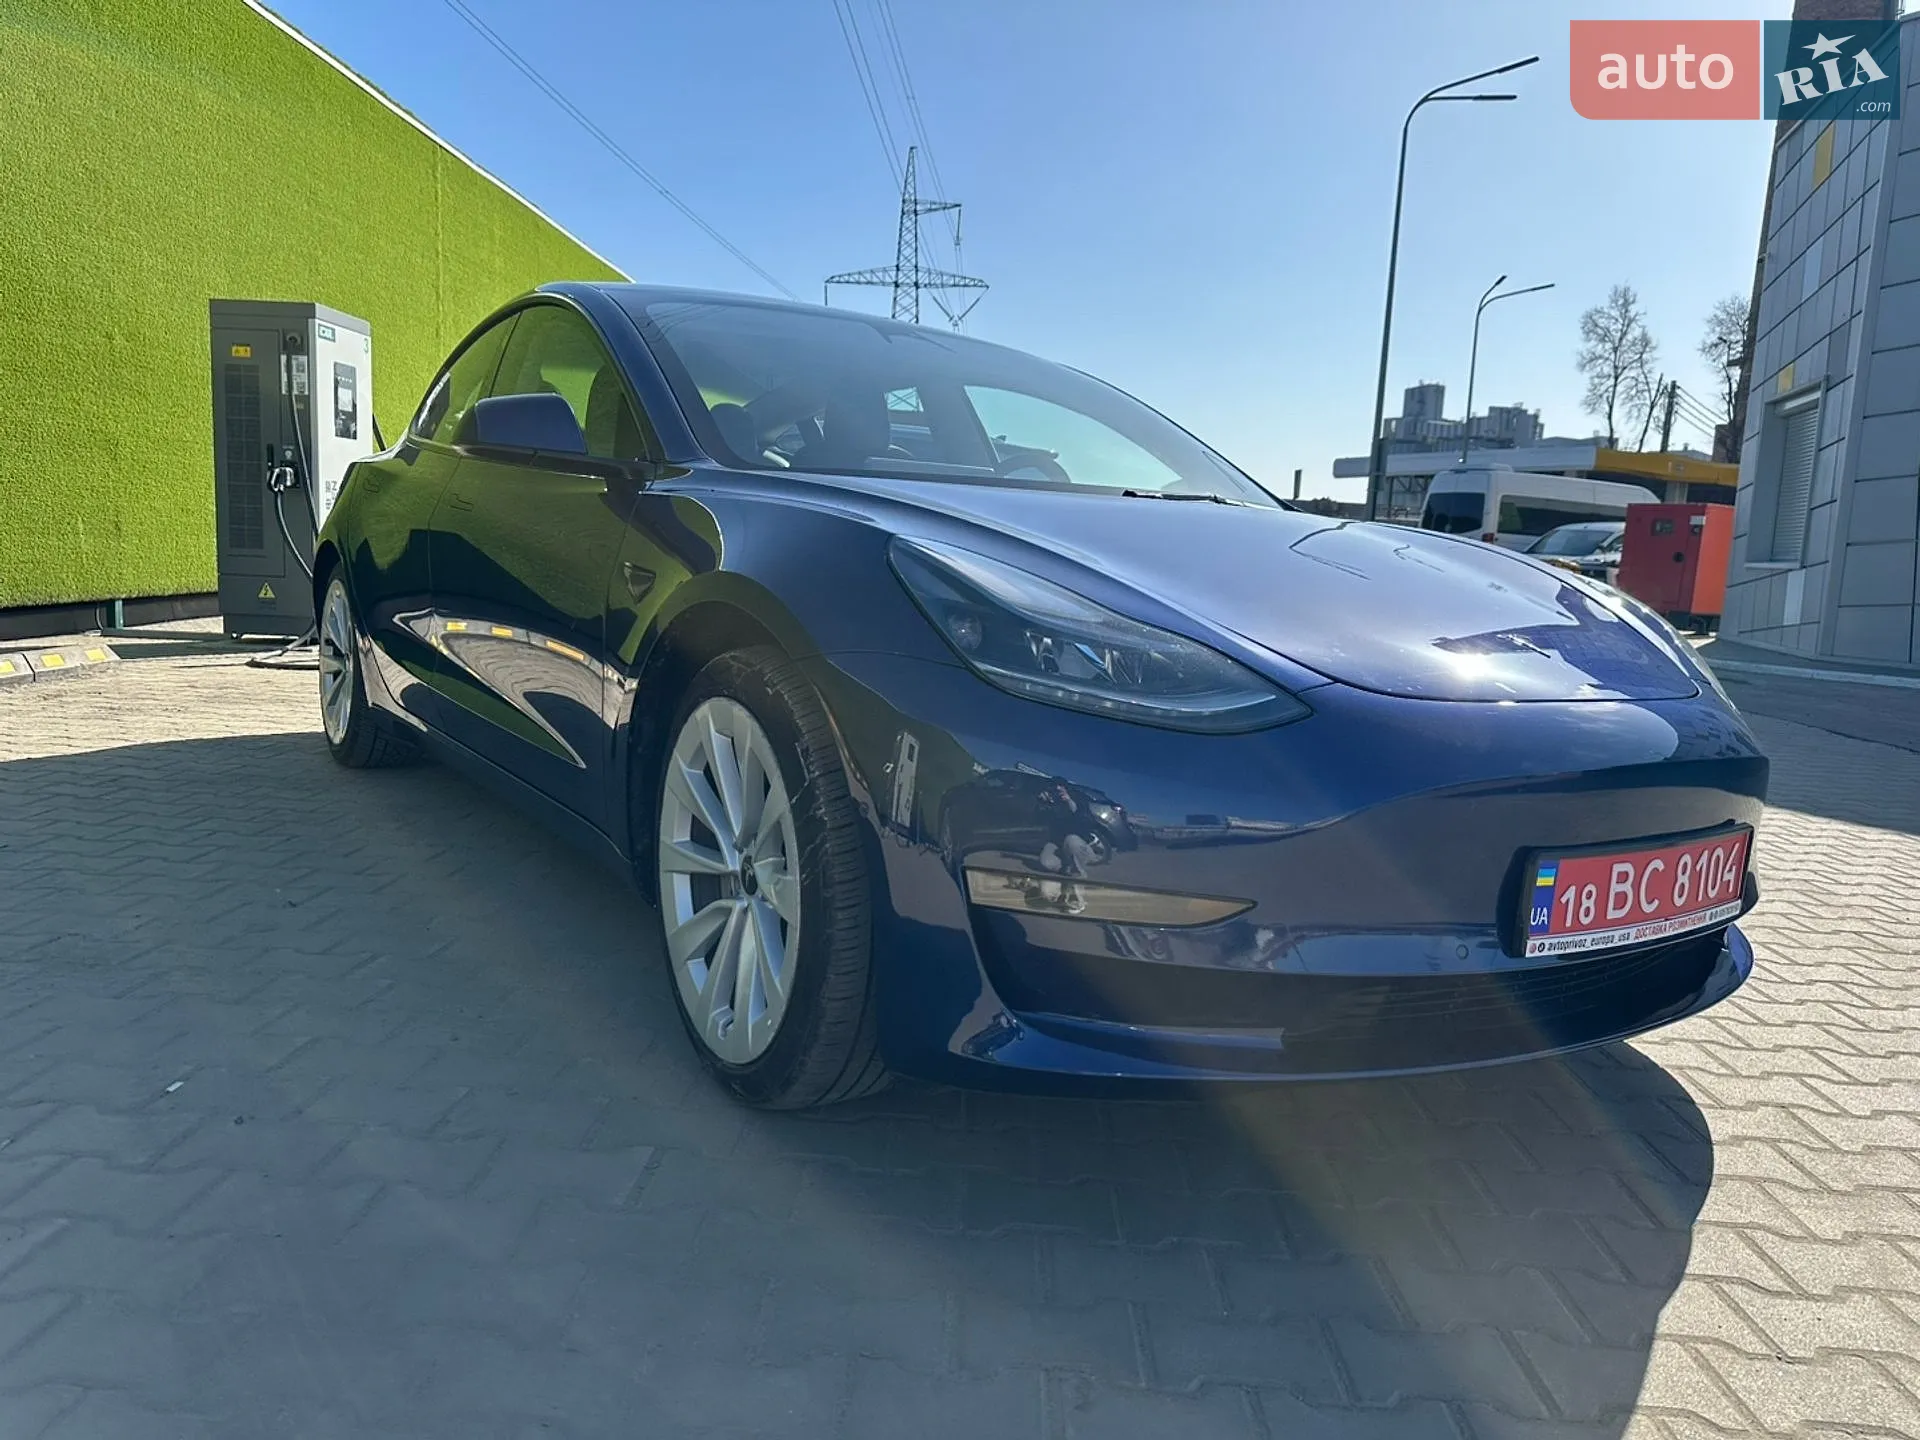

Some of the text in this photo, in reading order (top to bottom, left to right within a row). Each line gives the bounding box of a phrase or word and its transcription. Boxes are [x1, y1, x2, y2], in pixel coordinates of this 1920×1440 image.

[1560, 842, 1740, 928] 18 BC 8104
[1530, 907, 1548, 926] UA
